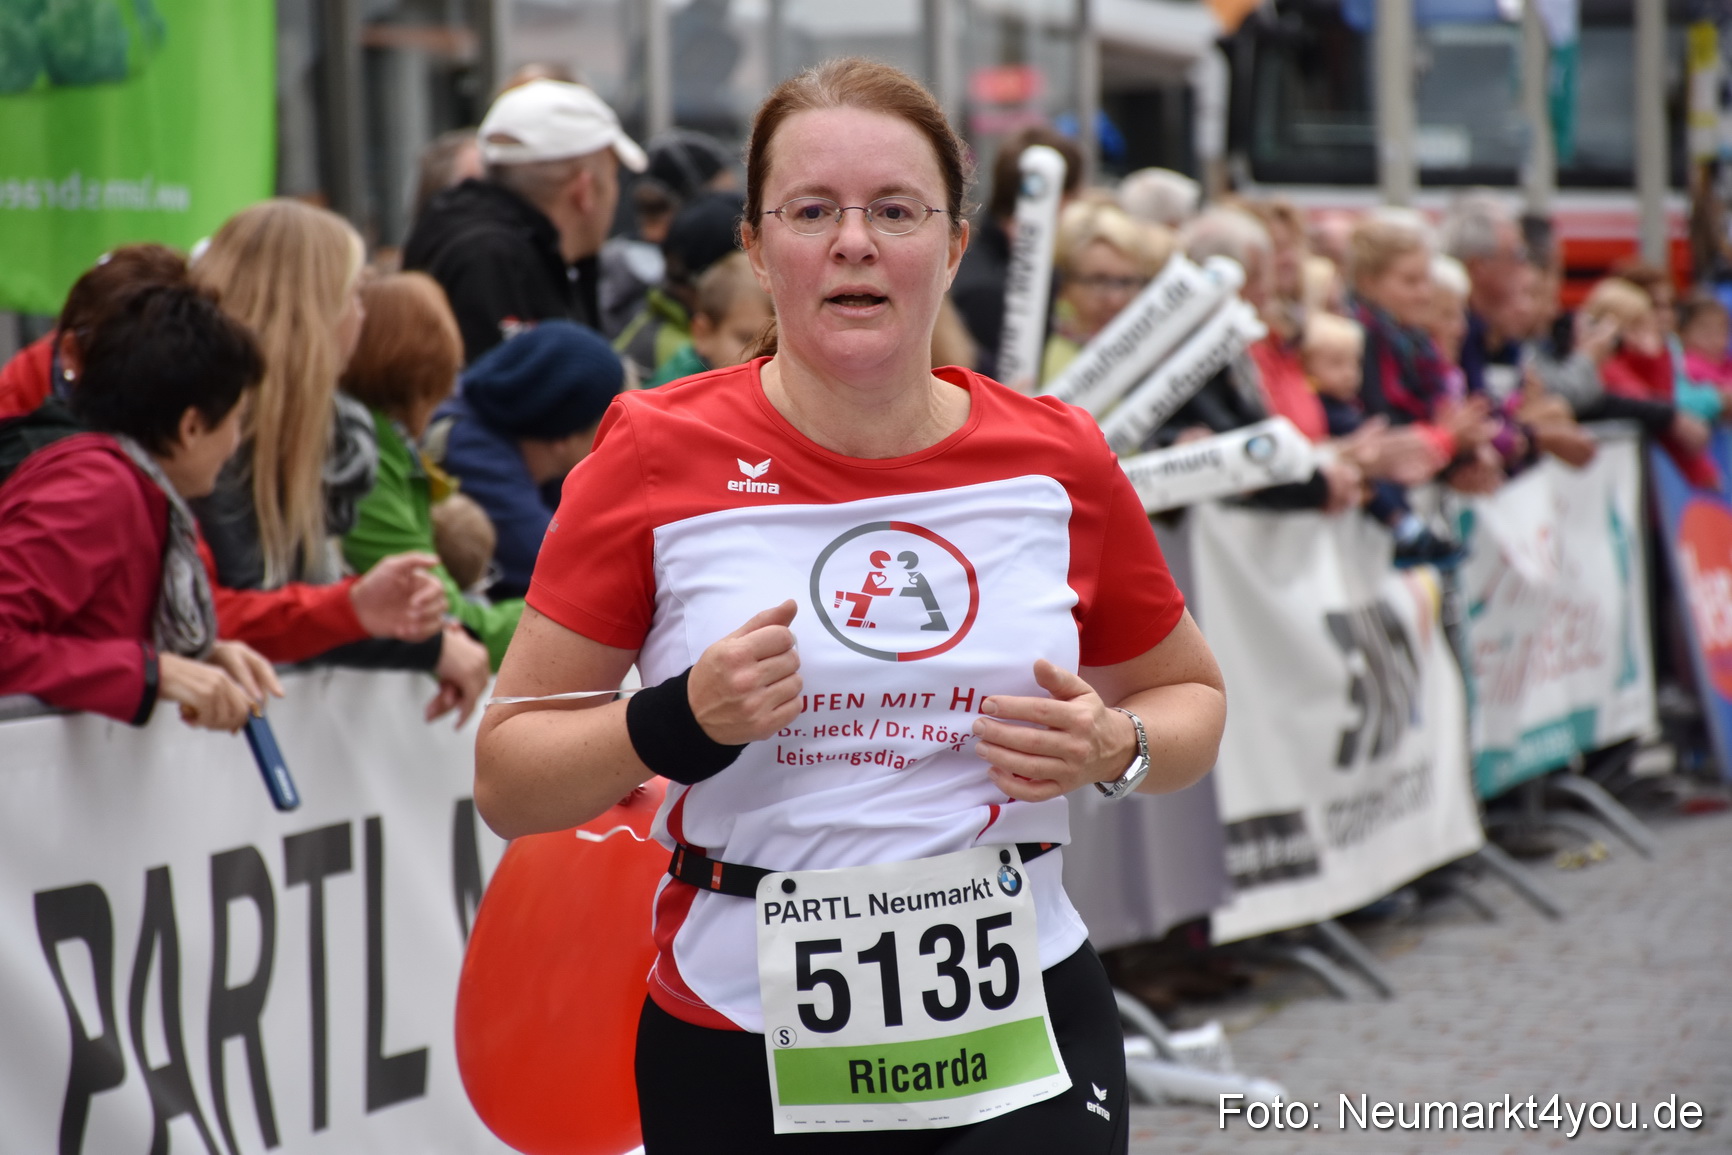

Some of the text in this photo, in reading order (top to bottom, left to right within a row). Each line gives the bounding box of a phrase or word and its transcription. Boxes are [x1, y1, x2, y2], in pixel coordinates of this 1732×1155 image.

[727, 478, 780, 495] erima
[800, 693, 865, 714] UFEN
[880, 693, 936, 709] MIT
[813, 719, 864, 738] Heck
[869, 719, 880, 740] /
[886, 721, 915, 739] Dr.
[921, 724, 976, 744] Rösc
[764, 878, 993, 925] PARTL Neumarkt
[33, 814, 430, 1155] PARTL
[795, 911, 1020, 1034] 5135
[779, 1029, 790, 1046] S
[848, 1048, 988, 1094] Ricarda
[1086, 1101, 1110, 1122] erima
